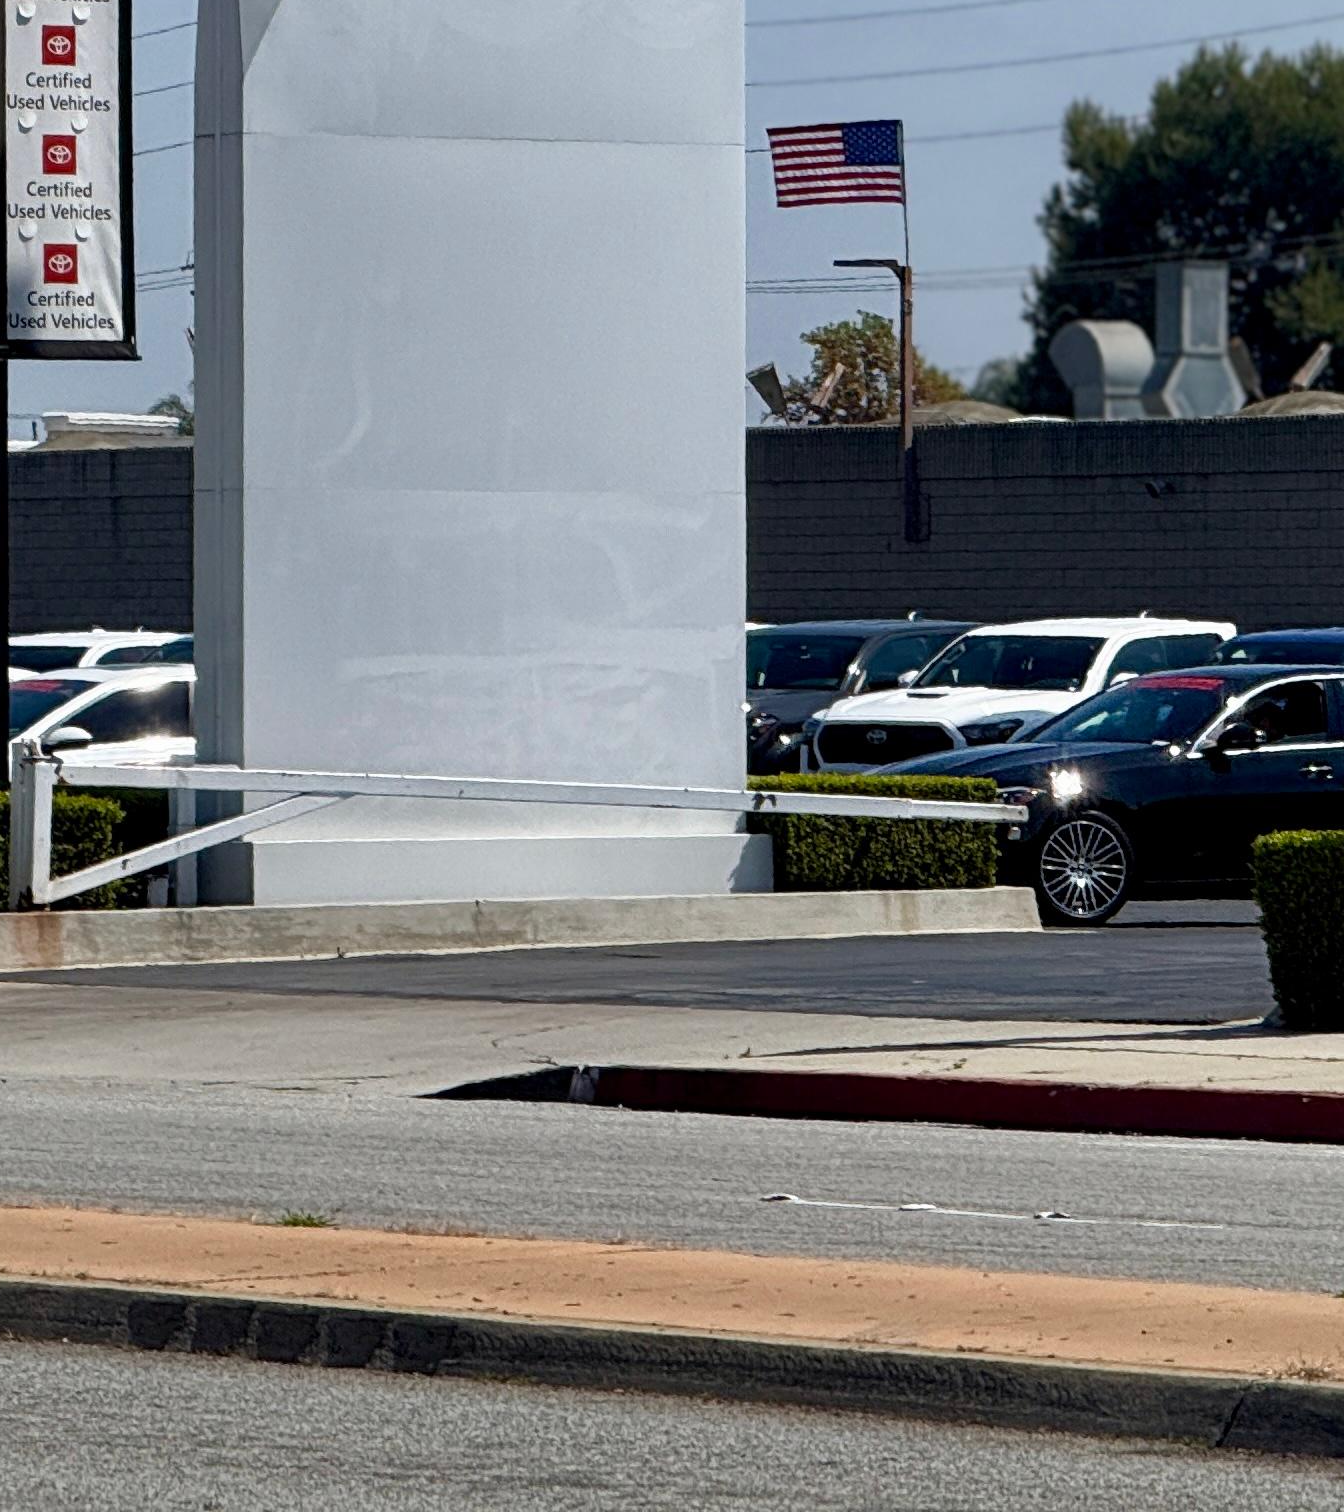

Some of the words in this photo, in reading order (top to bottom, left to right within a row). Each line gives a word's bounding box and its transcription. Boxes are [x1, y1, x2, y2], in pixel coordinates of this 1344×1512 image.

[26, 72, 91, 89] Certified
[7, 94, 44, 110] Used
[50, 94, 111, 112] Vehicles
[27, 181, 92, 198] Certified
[8, 203, 45, 219] Used
[51, 204, 112, 220] Vehicles
[28, 291, 95, 307] Certified
[9, 312, 46, 328] Used
[51, 313, 115, 329] Vehicles
